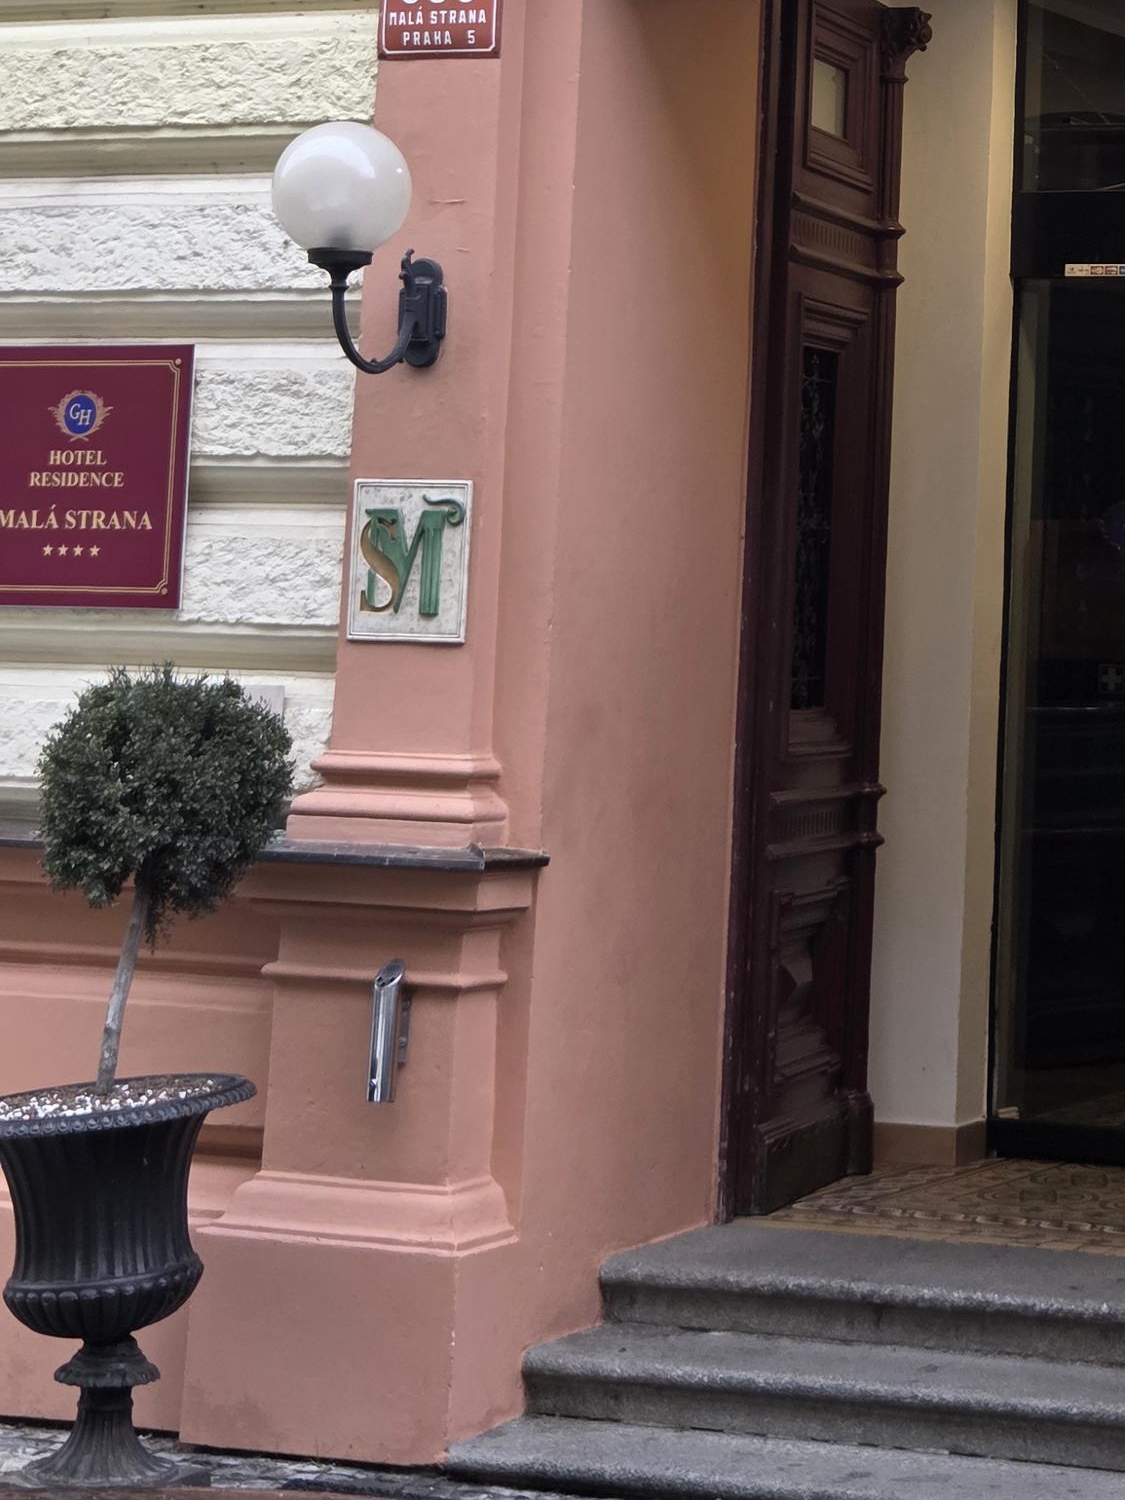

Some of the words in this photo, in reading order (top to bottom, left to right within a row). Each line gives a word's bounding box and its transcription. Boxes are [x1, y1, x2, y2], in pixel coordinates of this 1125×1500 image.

[388, 6, 424, 27] MALÁ
[429, 8, 487, 25] STRANA
[402, 30, 453, 47] PRAHA
[466, 29, 476, 45] 5
[69, 403, 92, 426] GH
[49, 450, 107, 466] HOTEL
[29, 471, 125, 488] RESIDENCE
[0, 504, 60, 529] MALÁ
[64, 510, 153, 531] STRANA
